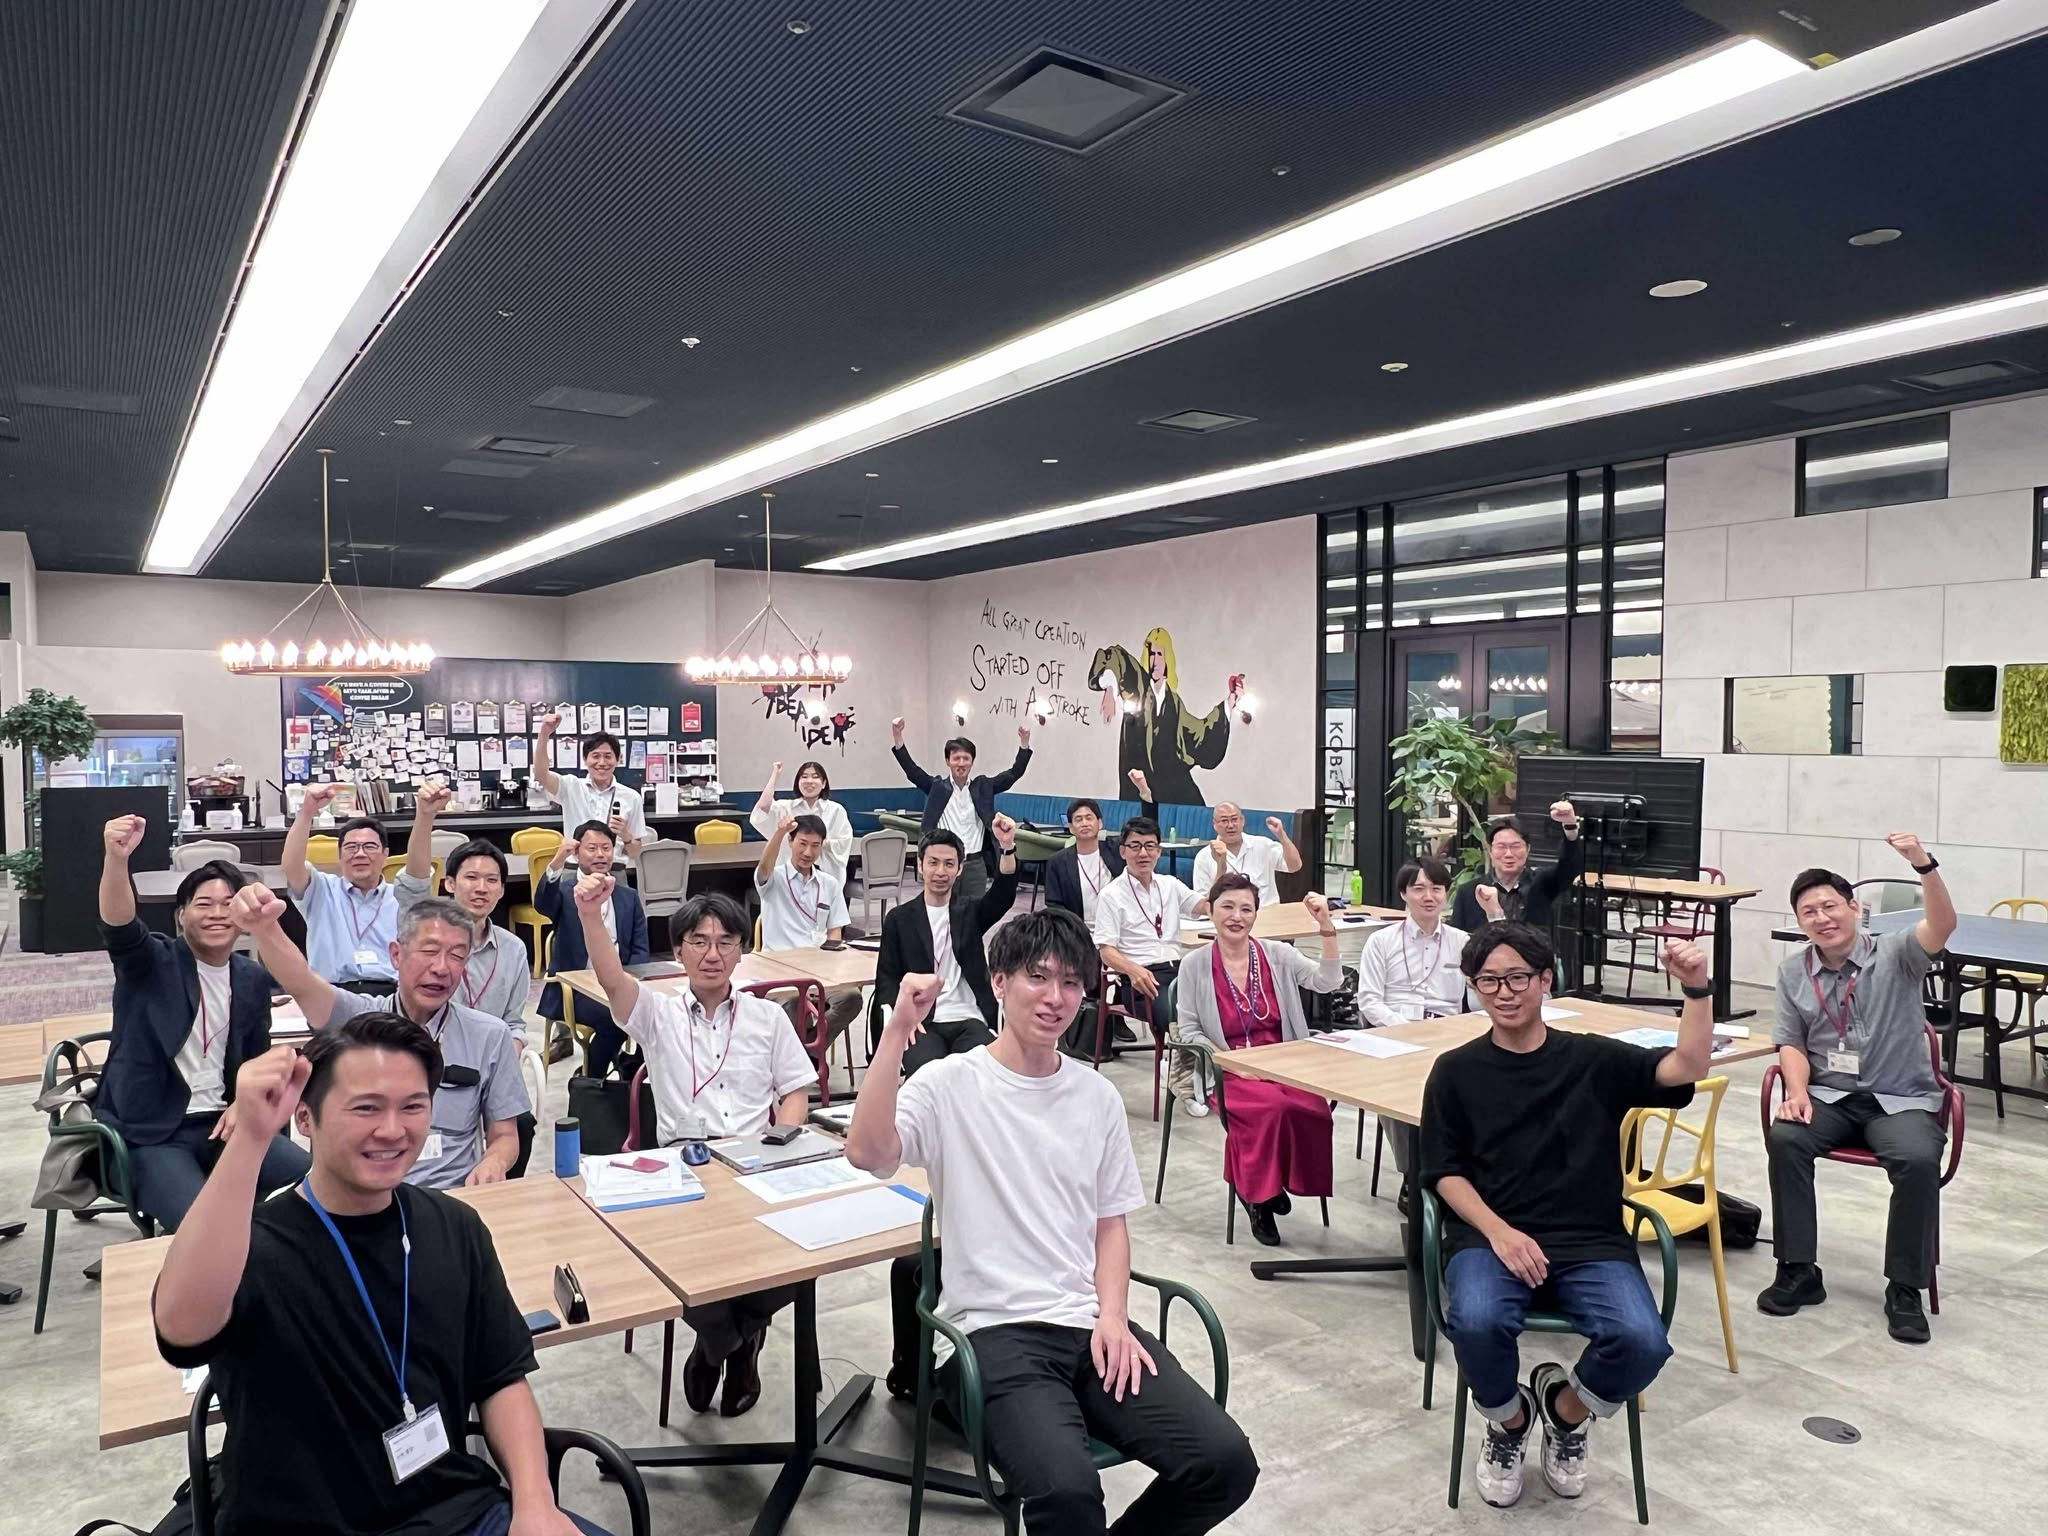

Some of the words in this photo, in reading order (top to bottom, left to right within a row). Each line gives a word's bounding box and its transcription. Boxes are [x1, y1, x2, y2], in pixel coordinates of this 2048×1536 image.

[1035, 619, 1087, 651] CREATION
[970, 644, 1029, 691] STARTED
[1037, 660, 1065, 689] OFF
[1025, 686, 1037, 717] A
[1047, 694, 1090, 725] STROKE
